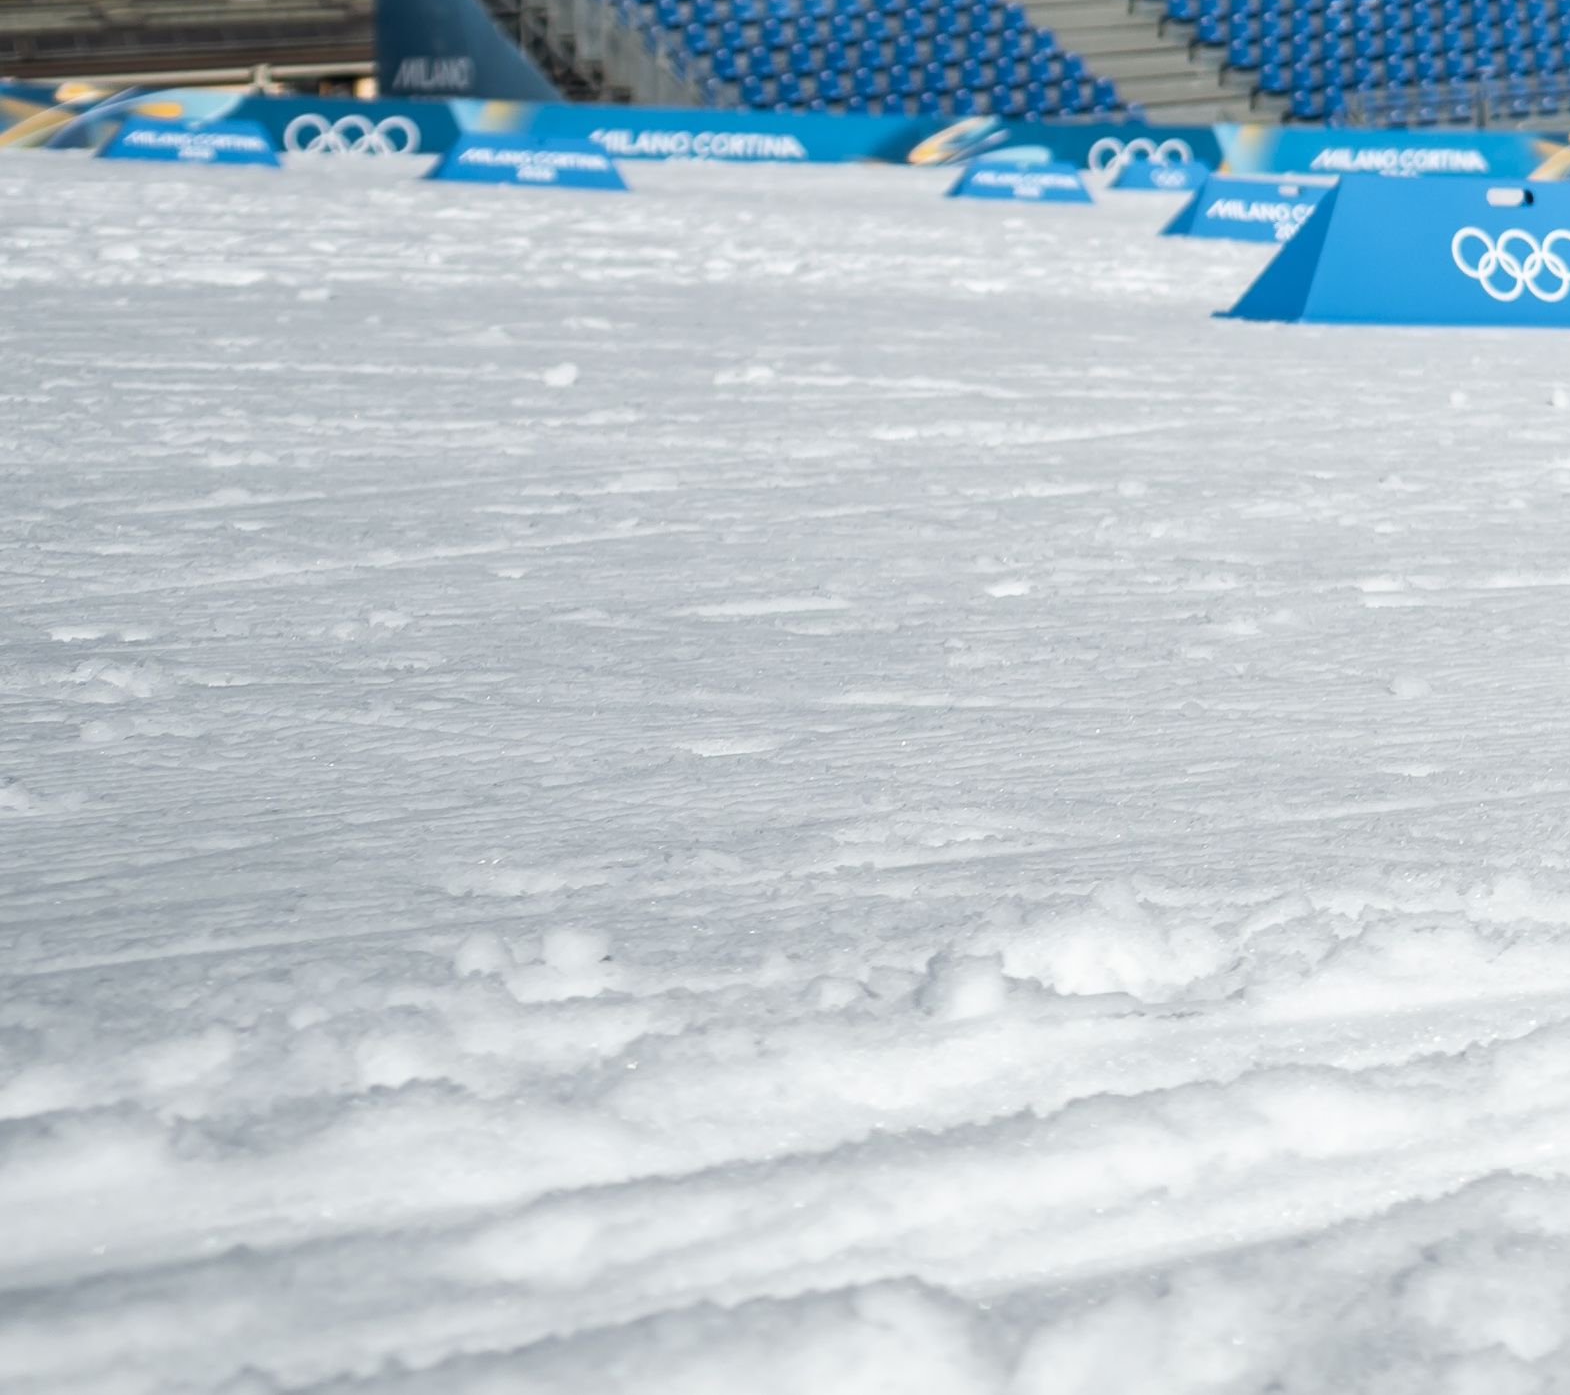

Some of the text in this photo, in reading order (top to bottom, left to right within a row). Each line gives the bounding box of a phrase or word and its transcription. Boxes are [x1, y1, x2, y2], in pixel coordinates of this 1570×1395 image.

[692, 132, 808, 159] CORTINA
[1310, 147, 1489, 172] MILANO CORTINA
[1205, 198, 1290, 223] MILANO
